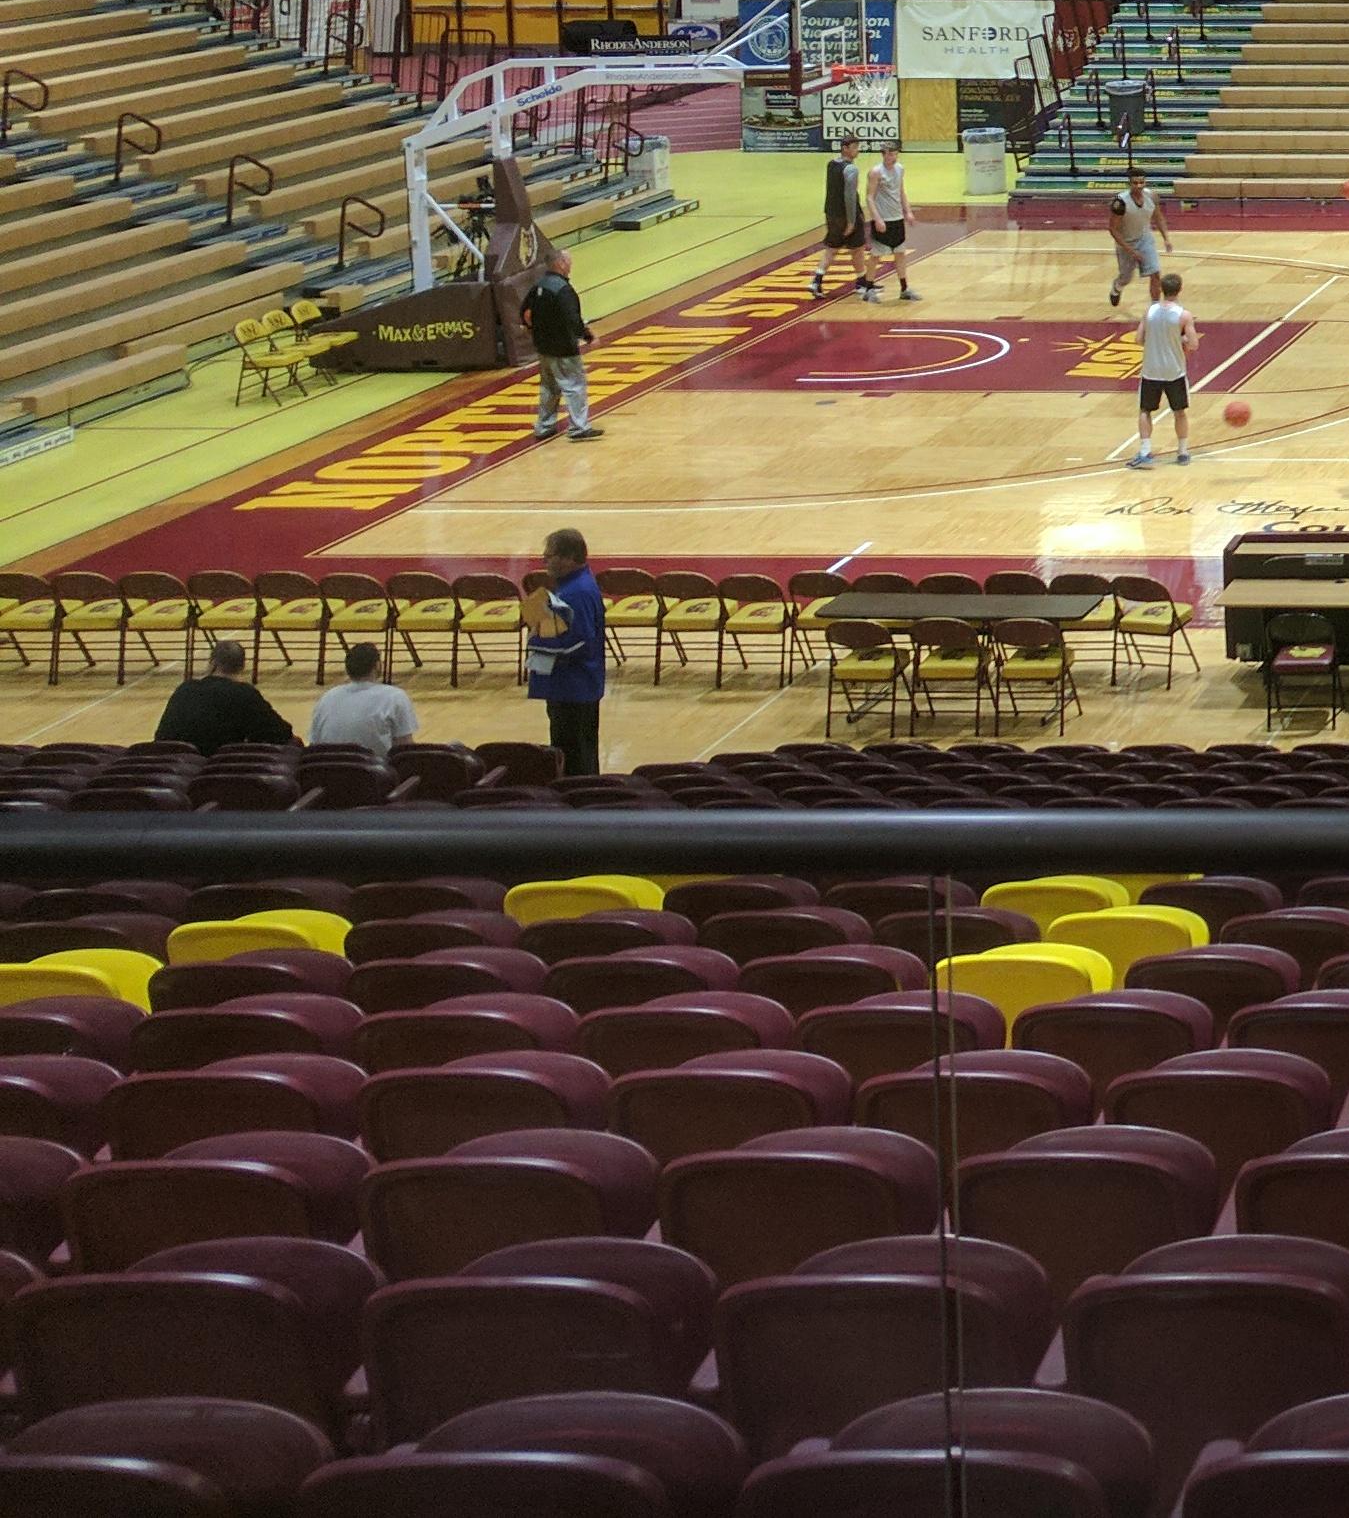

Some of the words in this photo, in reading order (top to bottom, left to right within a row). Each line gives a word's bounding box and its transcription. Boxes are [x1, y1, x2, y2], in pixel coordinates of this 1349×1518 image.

[801, 17, 839, 27] SOUTH
[922, 25, 1030, 42] SANFORD
[944, 46, 1010, 55] HEALTH
[831, 111, 892, 123] VOSIKA
[826, 126, 897, 138] FENCING
